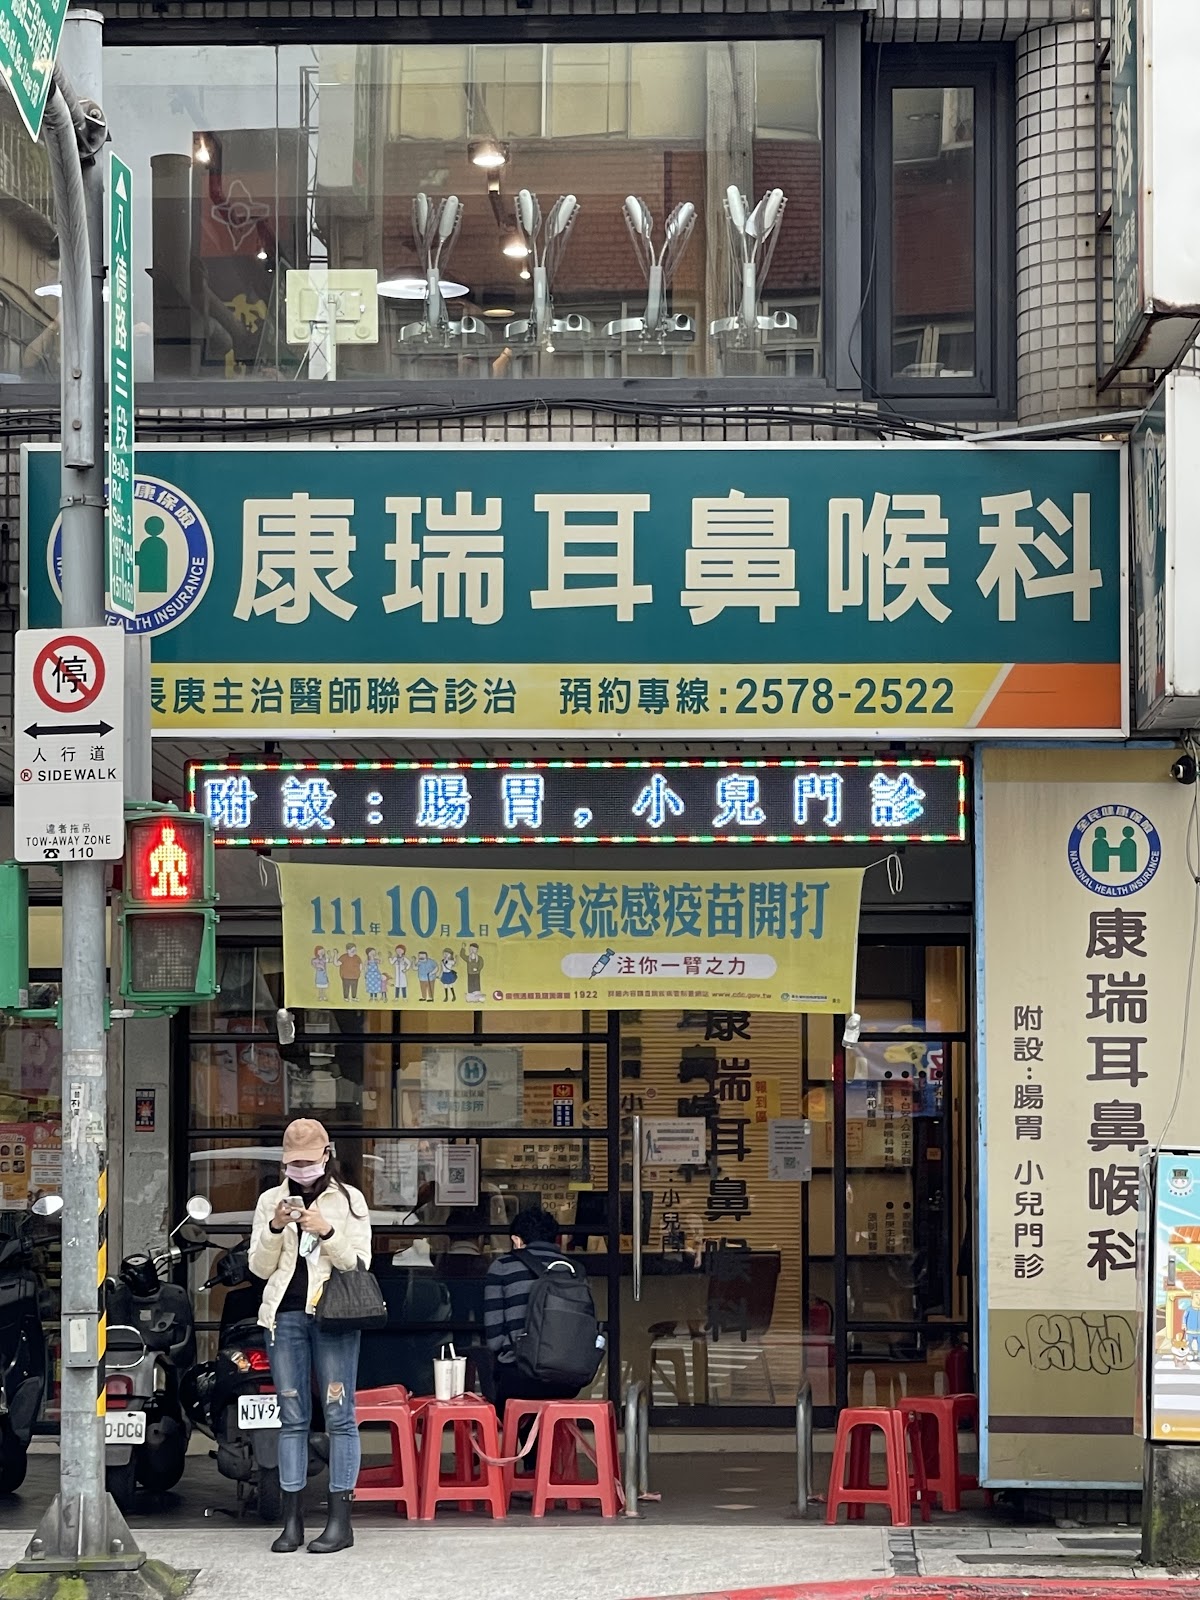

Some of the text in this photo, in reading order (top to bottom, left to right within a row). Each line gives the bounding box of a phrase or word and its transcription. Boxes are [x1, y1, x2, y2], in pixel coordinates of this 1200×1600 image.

[113, 204, 128, 452] 八德路三段
[112, 453, 129, 482] BaDe
[112, 479, 123, 503] Rd.
[112, 506, 132, 534] Sec. 3
[233, 488, 1103, 625] 康瑞耳鼻喉科
[153, 556, 206, 625] INSURANCE
[52, 655, 87, 693] 停
[559, 677, 954, 716] 預約專線:2578-2522
[32, 745, 105, 763] 人行道
[37, 767, 116, 782] SIDEWALK
[26, 834, 111, 847] TOW-AWAY ZONE
[69, 847, 94, 858] 110
[1069, 850, 1160, 896] NATIONAL HEALTH INSURANCE
[616, 955, 746, 976] 注你一臂之力
[573, 990, 598, 999] 1922
[711, 991, 772, 1000] www.cdc.gov.tw
[1086, 907, 1149, 1281] 康瑞耳鼻喉科
